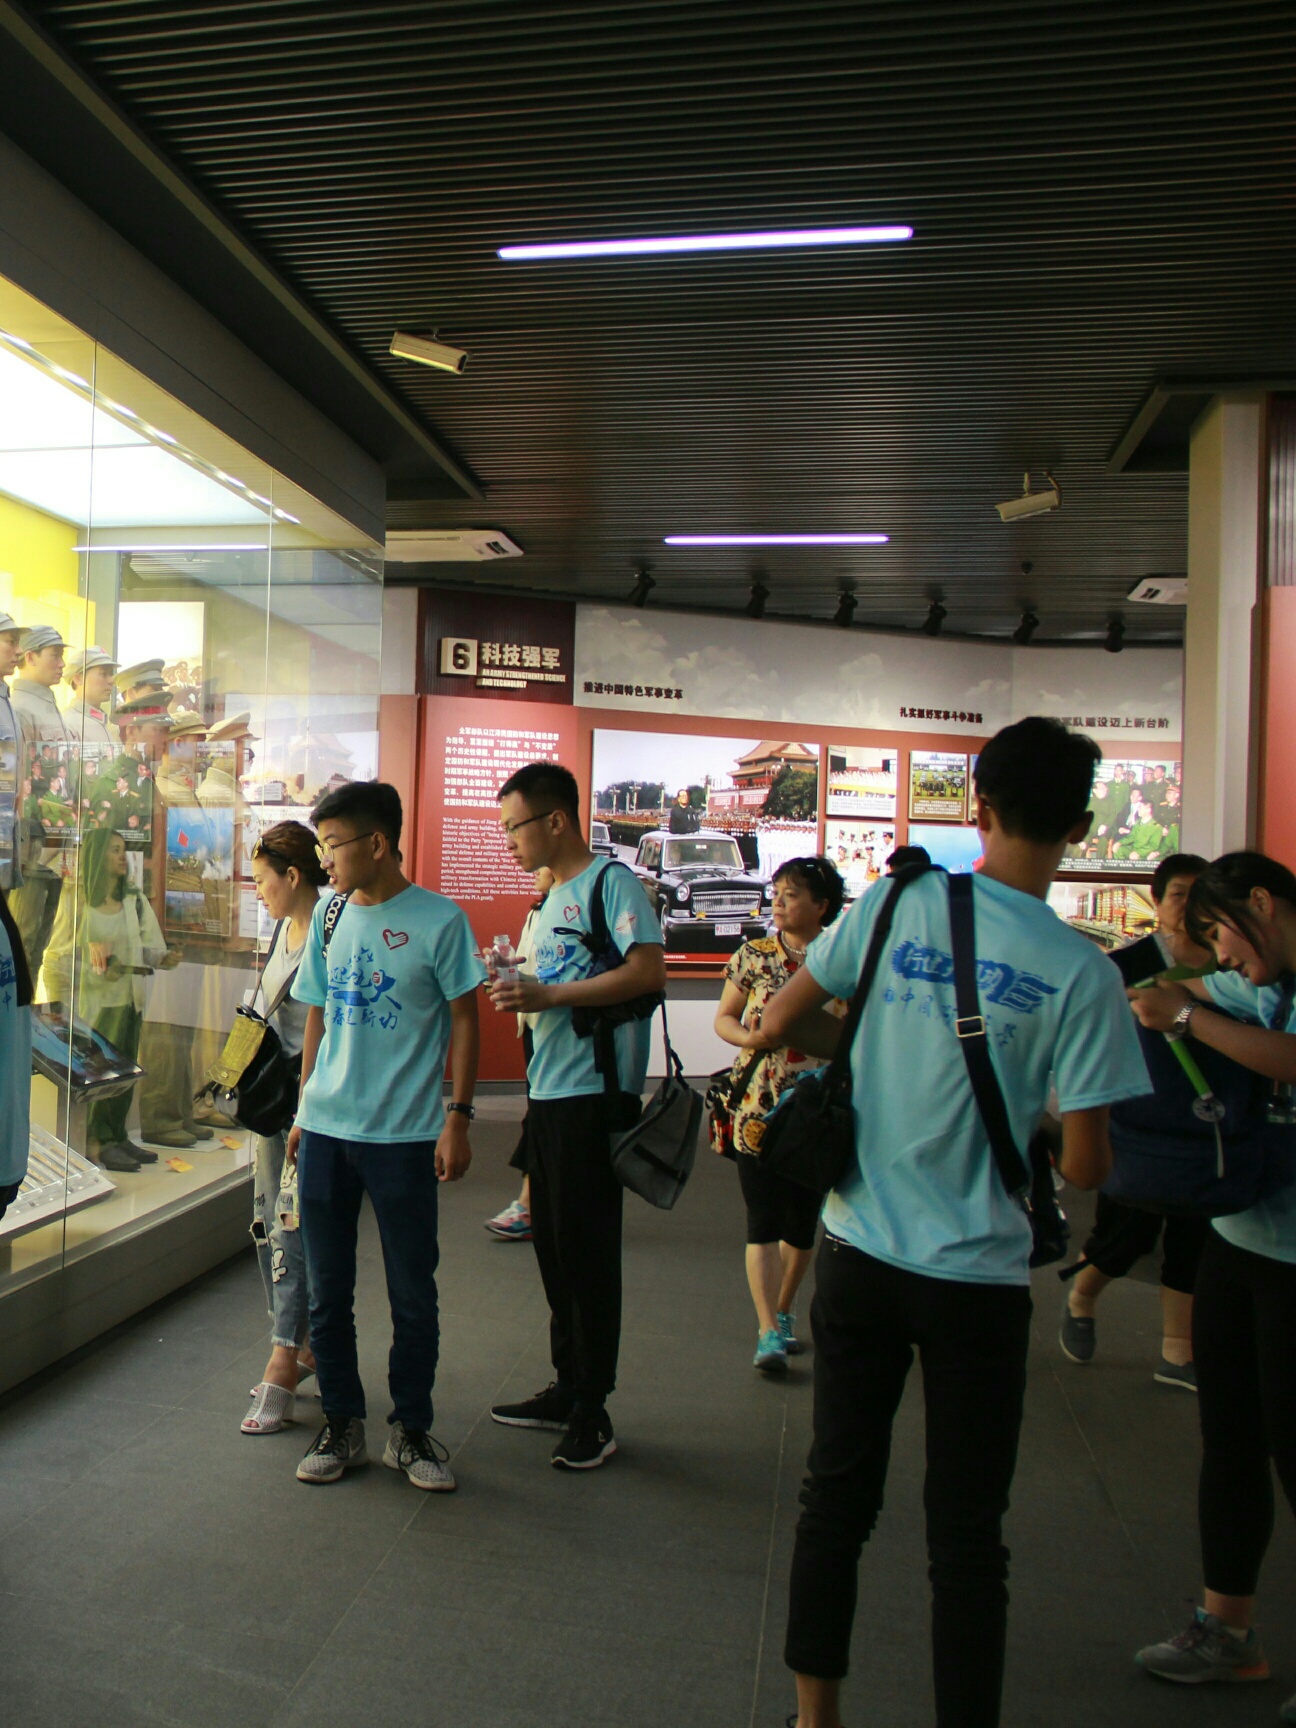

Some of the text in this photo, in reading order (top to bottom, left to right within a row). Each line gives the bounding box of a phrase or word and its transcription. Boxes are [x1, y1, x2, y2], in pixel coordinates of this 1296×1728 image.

[452, 642, 471, 670] 6
[481, 642, 561, 669] 科技强军
[584, 682, 683, 700] 推进中国特色军事变革
